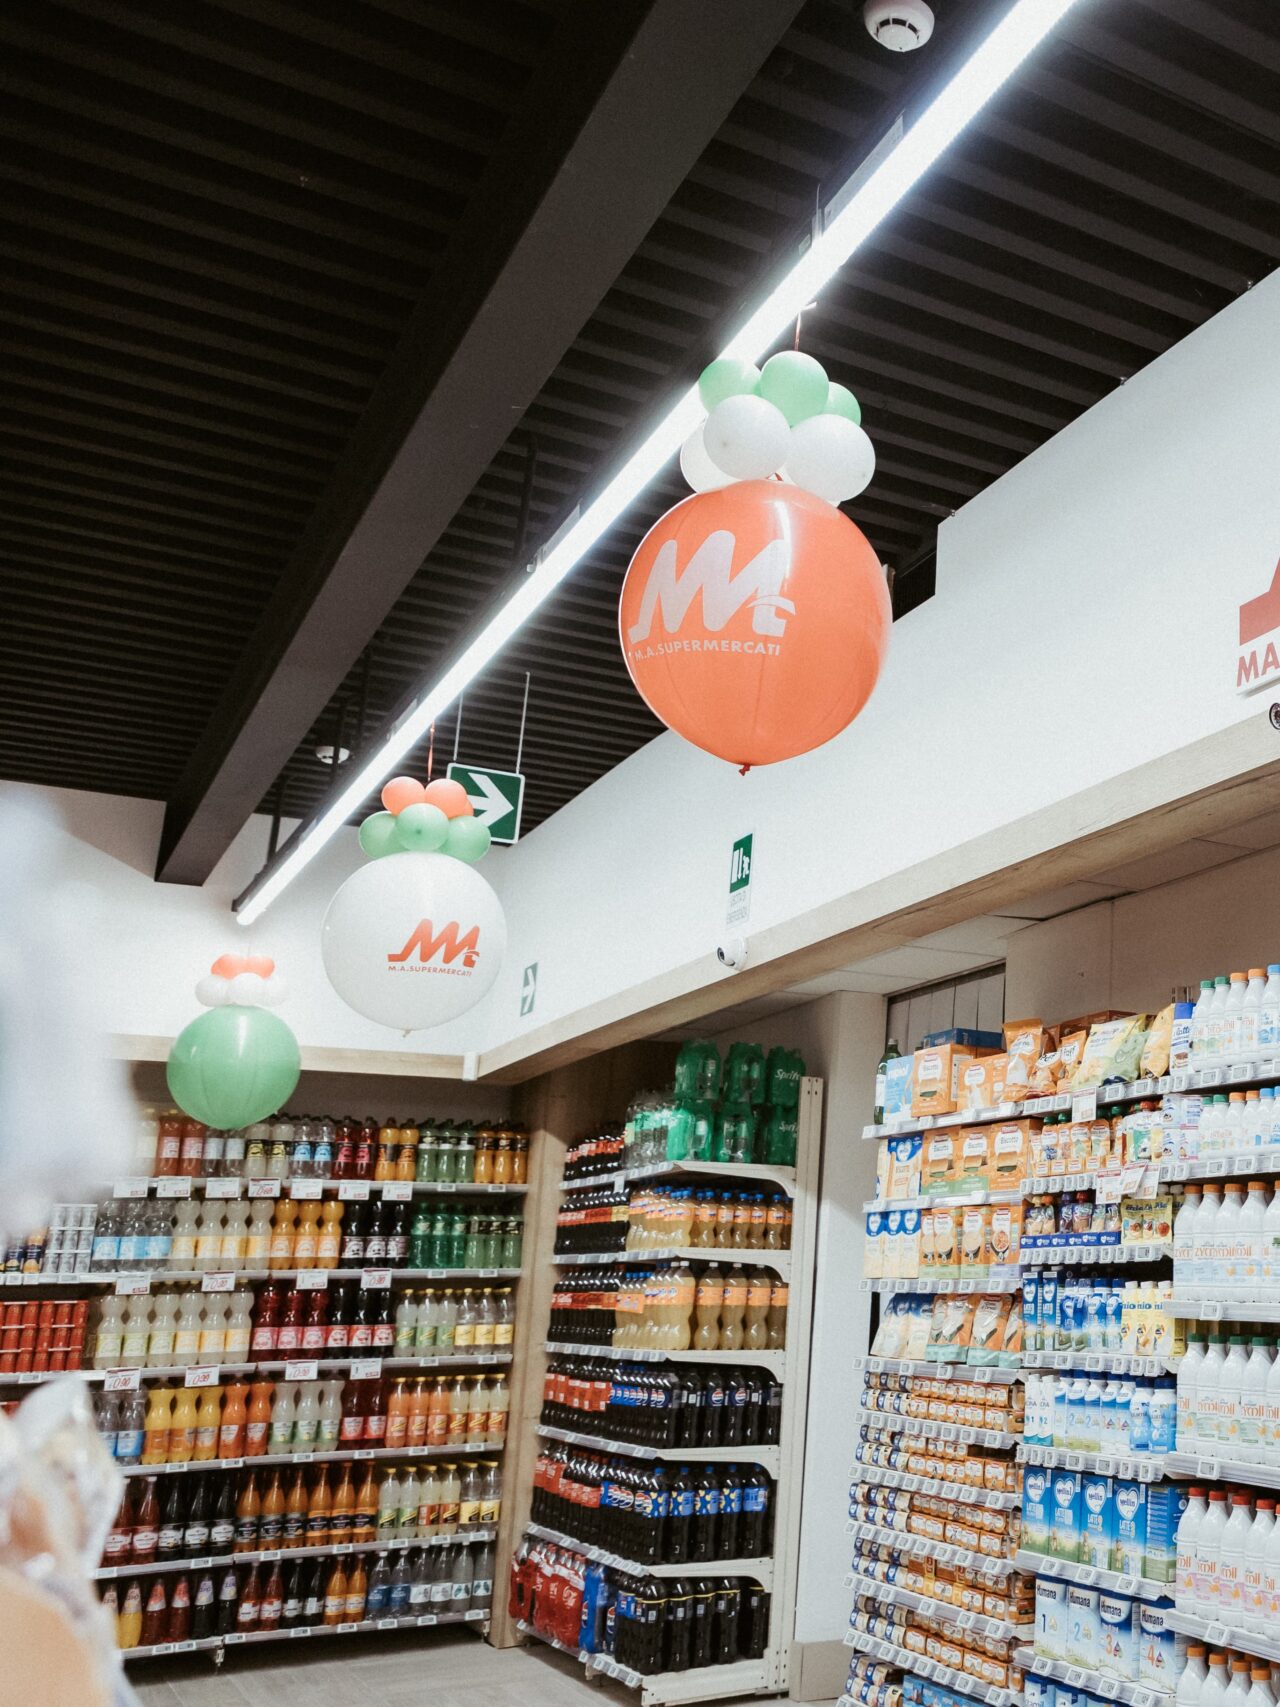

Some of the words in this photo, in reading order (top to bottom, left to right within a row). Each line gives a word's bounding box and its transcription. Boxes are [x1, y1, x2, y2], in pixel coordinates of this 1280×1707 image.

[634, 639, 781, 662] M.A.SUPERMERCATI
[774, 1068, 801, 1081] Sprit
[1037, 1585, 1057, 1600] Humana
[1069, 1591, 1091, 1608] Humana
[1100, 1601, 1122, 1617] Humana
[1141, 1610, 1164, 1626] Humana
[1041, 1613, 1047, 1633] 1
[1074, 1622, 1081, 1641] 2
[1105, 1634, 1113, 1655] 3
[1146, 1644, 1155, 1666] 4
